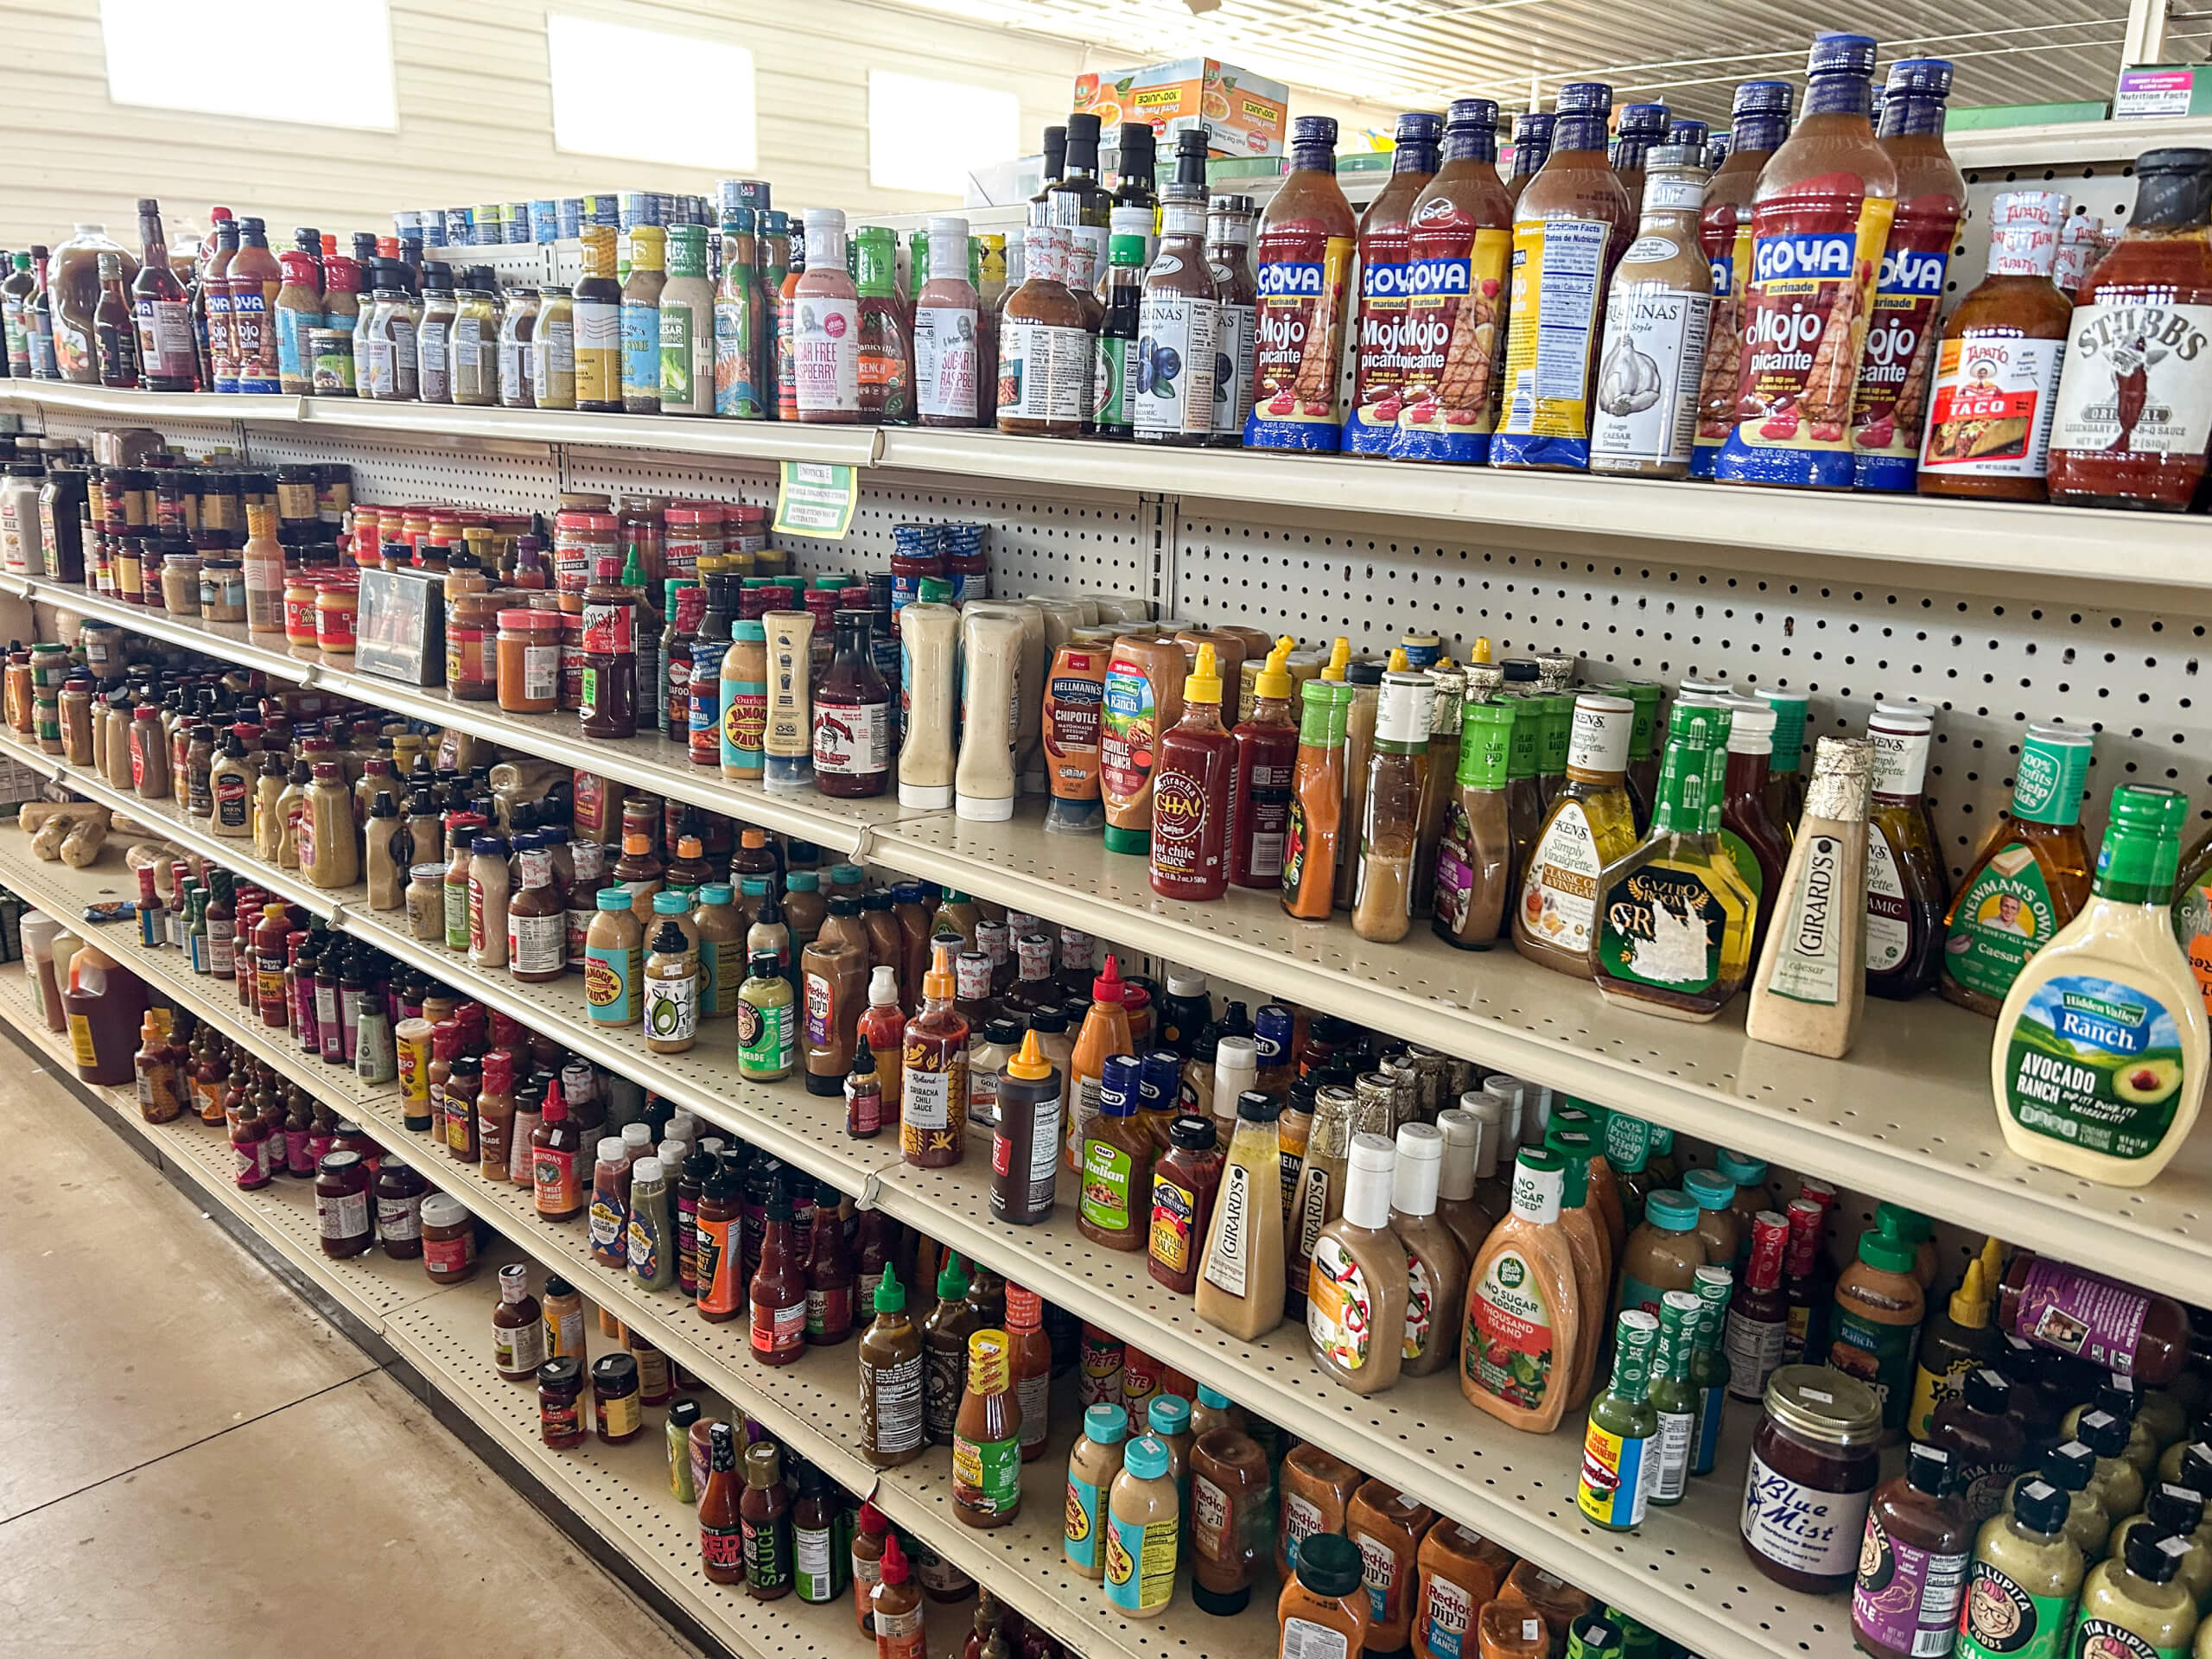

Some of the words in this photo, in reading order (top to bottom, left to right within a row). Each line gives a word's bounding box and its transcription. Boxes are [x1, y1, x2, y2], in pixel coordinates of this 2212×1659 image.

[1580, 223, 1600, 232] Facts
[1757, 239, 1849, 278] GOYA
[1258, 265, 1320, 296] GOYA
[1363, 268, 1408, 296] GOY
[1407, 263, 1465, 294] GOYA
[1587, 283, 1593, 292] 5
[234, 295, 264, 310] OYA
[1873, 297, 1912, 308] arinade
[1255, 314, 1305, 351] Mojo
[1405, 314, 1449, 352] Mojo
[1630, 322, 1652, 332] Style
[1745, 303, 1821, 353] Mojo
[794, 342, 814, 362] UGAR
[814, 342, 837, 362] FREE
[856, 342, 897, 357] ganicville
[1866, 317, 1916, 365] ojo
[1259, 348, 1301, 366] picante
[1751, 350, 1813, 375] picante
[1966, 345, 2009, 366] TAPATÍO
[858, 362, 886, 373] RENCH
[1859, 363, 1907, 383] cante
[1948, 401, 2005, 416] TACO
[1603, 432, 1631, 441] CAESAR
[2158, 427, 2186, 436] SAUCE
[802, 467, 825, 478] NOTICE
[1053, 682, 1103, 695] HELLMANN'S
[1055, 709, 1098, 725] CHIPOTLE
[1102, 736, 1129, 757] NASHVILLE
[1110, 753, 1131, 771] RANCH
[2023, 752, 2051, 773] 100%
[1154, 791, 1201, 818] CHA!
[1555, 818, 1588, 841] KEN'S
[1168, 844, 1196, 861] chile
[1544, 846, 1592, 874] Vinaigrette
[1551, 838, 1586, 860] Simply
[1156, 854, 1186, 868] sauce
[1544, 865, 1582, 882] CLASSIC
[1637, 874, 1700, 899] GAZEBO
[1799, 855, 1834, 951] GIRARD'S
[1963, 878, 2037, 922] NEWMAN'S
[2032, 897, 2051, 944] OWN
[2008, 936, 2021, 944] ALL
[1978, 942, 2022, 964] Caesar
[1789, 960, 1826, 976] caesar
[807, 983, 831, 1002] RedHot
[808, 996, 829, 1014] Dip'n
[2065, 995, 2104, 1014] Hidden
[2103, 1003, 2140, 1027] Valley
[744, 1052, 765, 1063] VERDE
[2020, 1052, 2097, 1095] AVOCADO
[910, 1085, 939, 1097] SRIRACHA
[915, 1096, 931, 1104] CHILI
[2016, 1074, 2060, 1104] RANCH
[913, 1103, 933, 1113] SAUCE
[1095, 1145, 1115, 1158] KRAFT
[1084, 1158, 1125, 1184] Italian
[1519, 1176, 1535, 1191] NO
[1223, 1178, 1244, 1255] GIRARD'S
[1303, 1180, 1325, 1255] GIRARD'S
[1152, 1224, 1185, 1250] COCKTAIL
[1154, 1237, 1179, 1260] SAUCE
[1501, 1271, 1522, 1283] Bone
[1484, 1280, 1499, 1296] NO
[1500, 1287, 1539, 1314] SUGAR
[1491, 1296, 1522, 1316] ADDED
[1482, 1302, 1534, 1335] THOUSAND
[1488, 1317, 1522, 1339] ISLAND
[1086, 1351, 1119, 1370] PETE
[1592, 1430, 1610, 1450] SAUCE
[1195, 1484, 1227, 1516] RedHot
[1759, 1474, 1829, 1518] Blue
[1286, 1503, 1323, 1533] RedHot
[1762, 1505, 1834, 1542] Mist
[701, 1529, 741, 1553] RED
[1760, 1522, 1800, 1548] Barbecue
[1801, 1541, 1829, 1554] Sauce
[756, 1525, 778, 1586] SAUCE
[1926, 1577, 1955, 1586] Calories
[1986, 1566, 2031, 1612] LUPITA
[1427, 1582, 1472, 1618] RedHot
[1430, 1600, 1467, 1630] Dip'n
[1970, 1625, 2003, 1651] FOODS
[2083, 1621, 2105, 1636] TIA
[1431, 1633, 1459, 1656] RANCH
